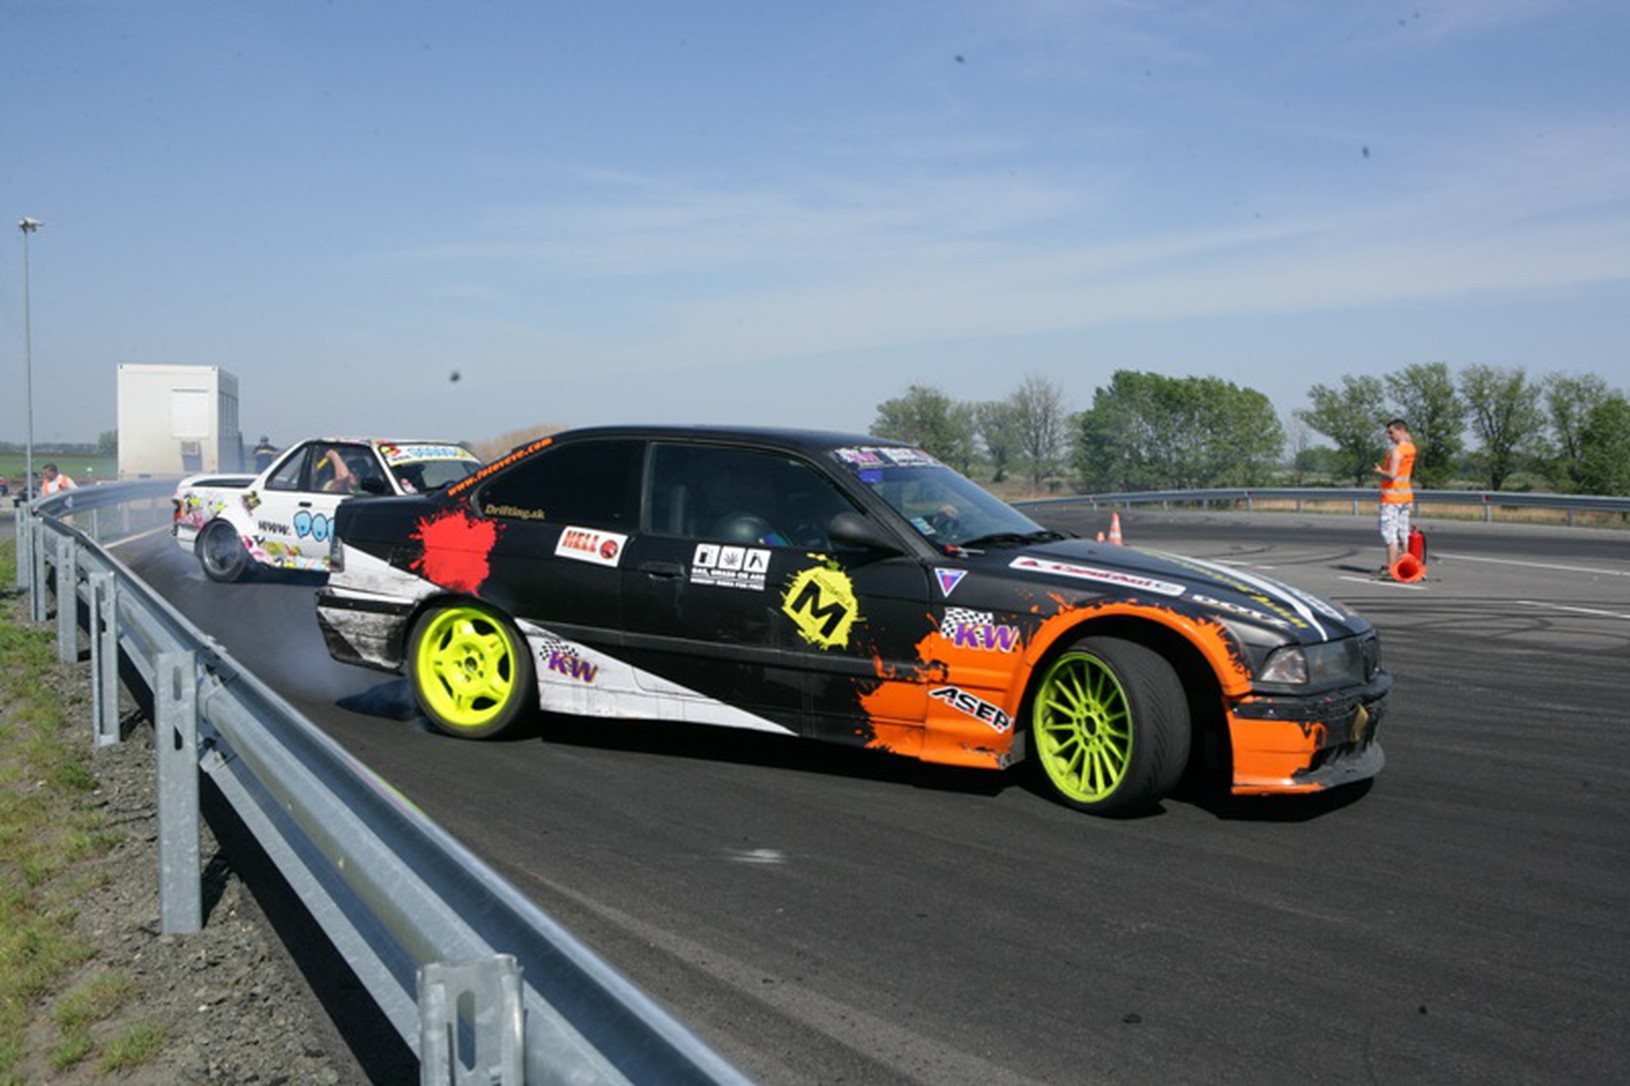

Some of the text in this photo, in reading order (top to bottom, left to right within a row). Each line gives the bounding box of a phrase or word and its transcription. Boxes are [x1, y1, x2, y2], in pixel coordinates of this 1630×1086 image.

[562, 530, 600, 553] HELL
[790, 579, 848, 639] M
[953, 622, 1020, 653] KW
[548, 651, 599, 683] KW
